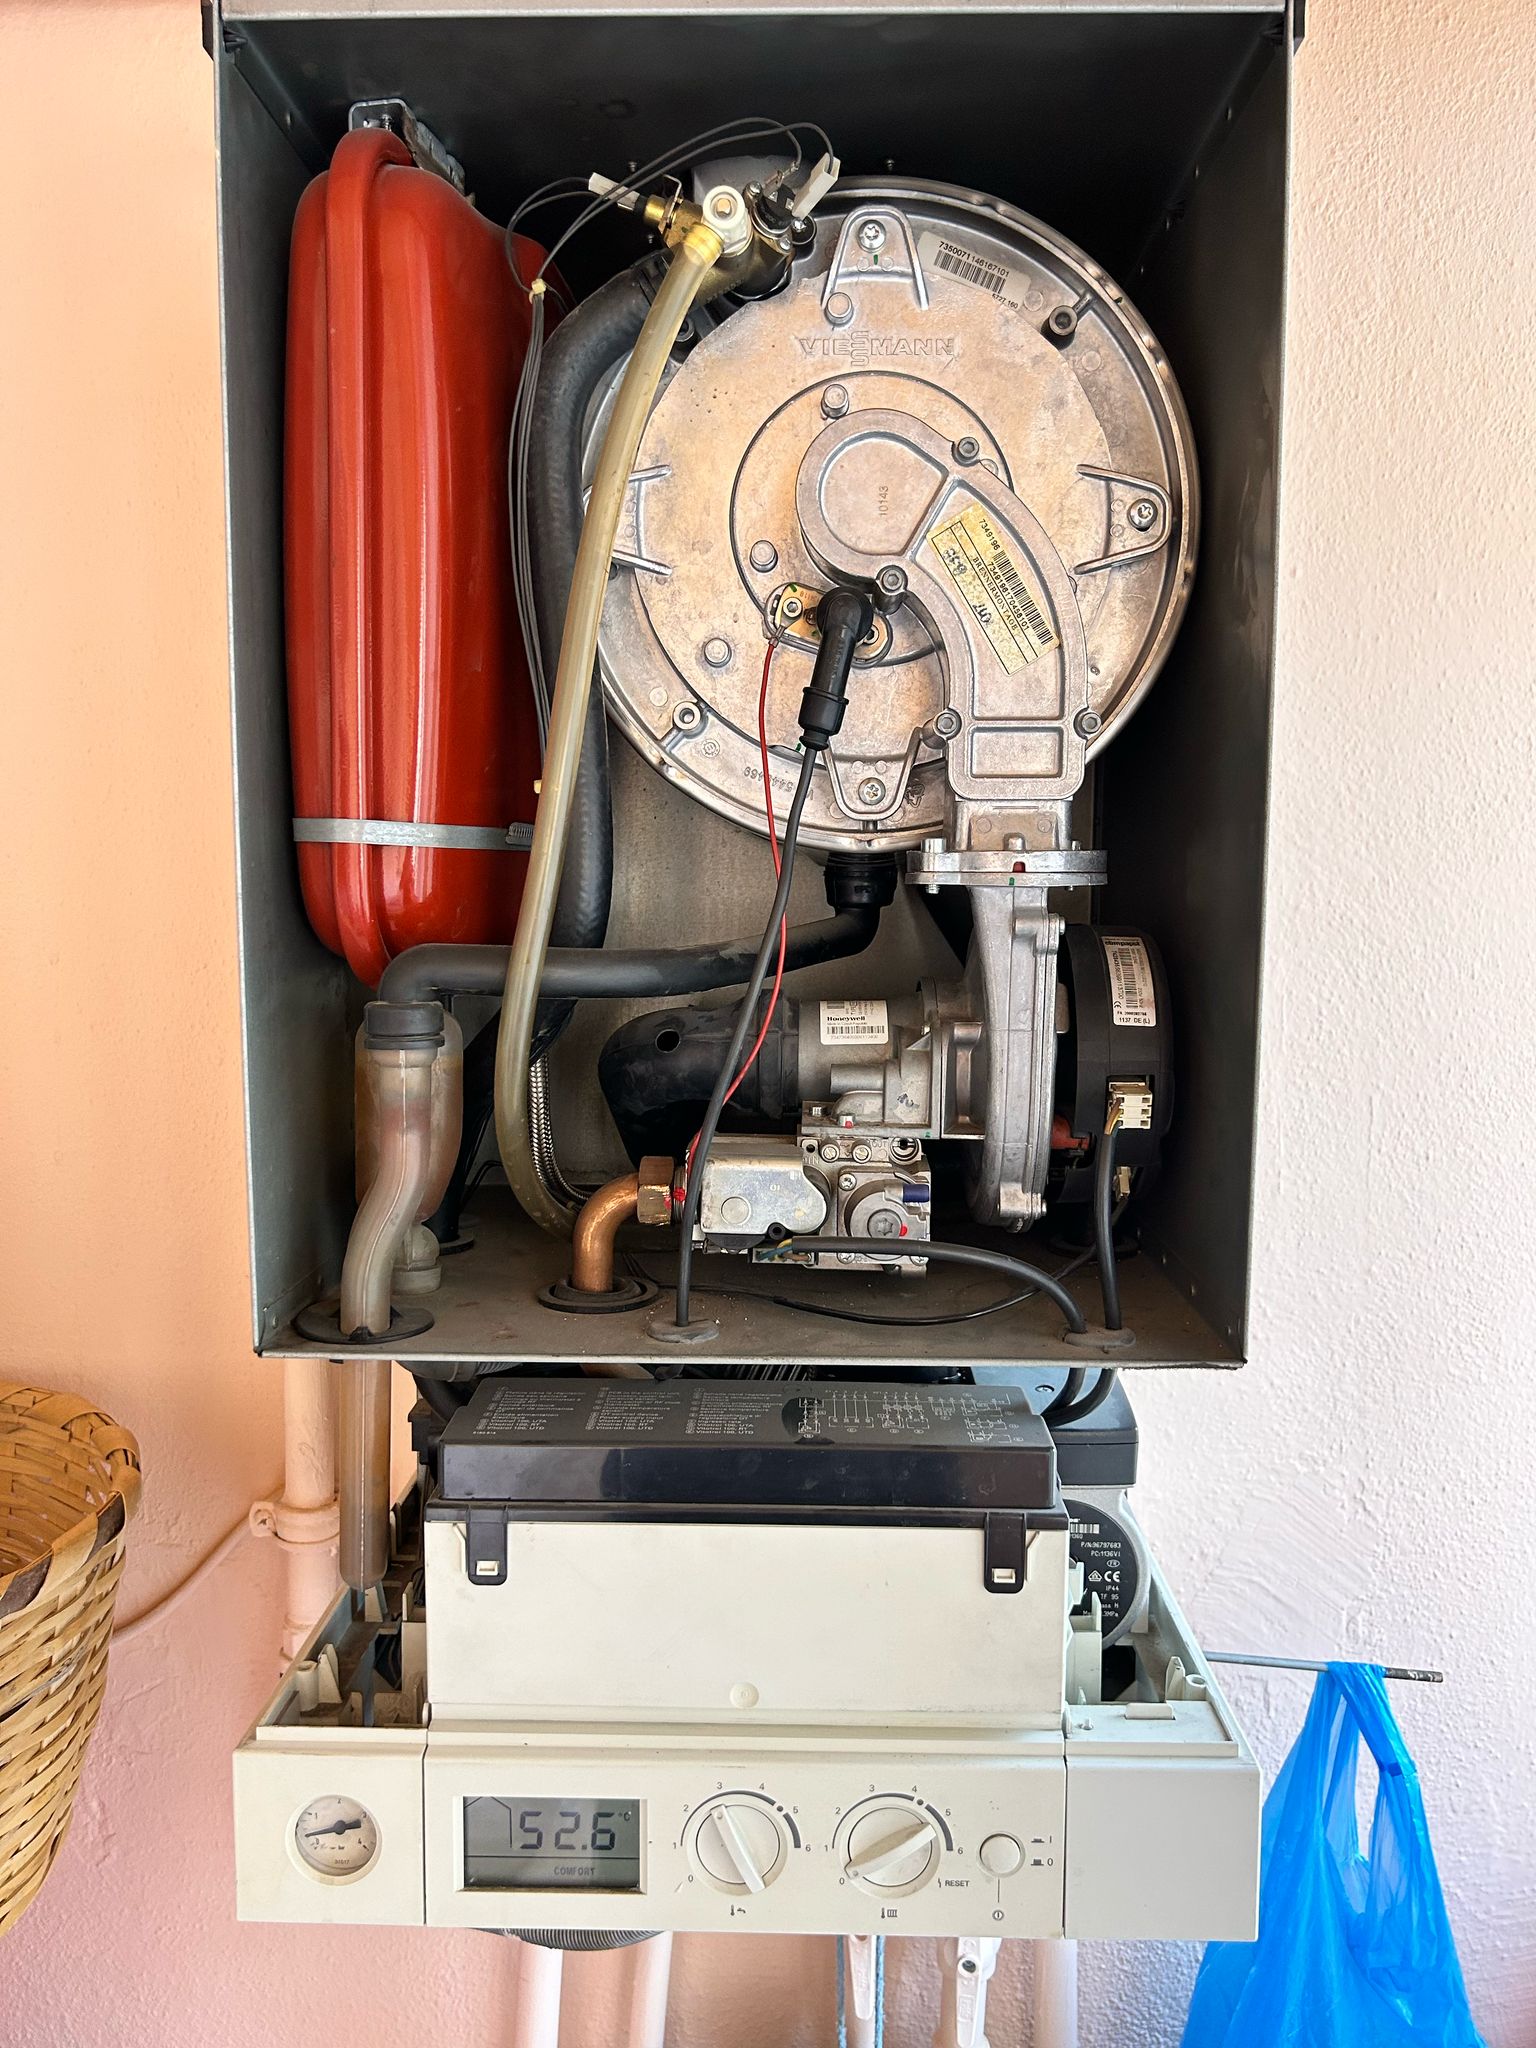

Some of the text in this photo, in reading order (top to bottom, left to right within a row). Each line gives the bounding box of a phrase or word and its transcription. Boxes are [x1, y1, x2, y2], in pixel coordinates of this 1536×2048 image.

[939, 240, 1010, 278] 7350071146167101
[798, 330, 955, 367] VIESSMANN
[878, 485, 889, 516] 10143
[978, 518, 1001, 551] 7349196
[972, 556, 1018, 631] BRENNERMONTAGE
[1104, 1571, 1121, 1582] CE
[912, 1785, 918, 1793] 4
[793, 1806, 799, 1814] 5
[835, 1807, 841, 1815] 2
[519, 1810, 616, 1851] 52.6
[805, 1844, 812, 1852] 6
[958, 1847, 964, 1855] 6
[1047, 1858, 1054, 1866] 0
[553, 1867, 596, 1876] COMFORT
[688, 1875, 694, 1883] 0
